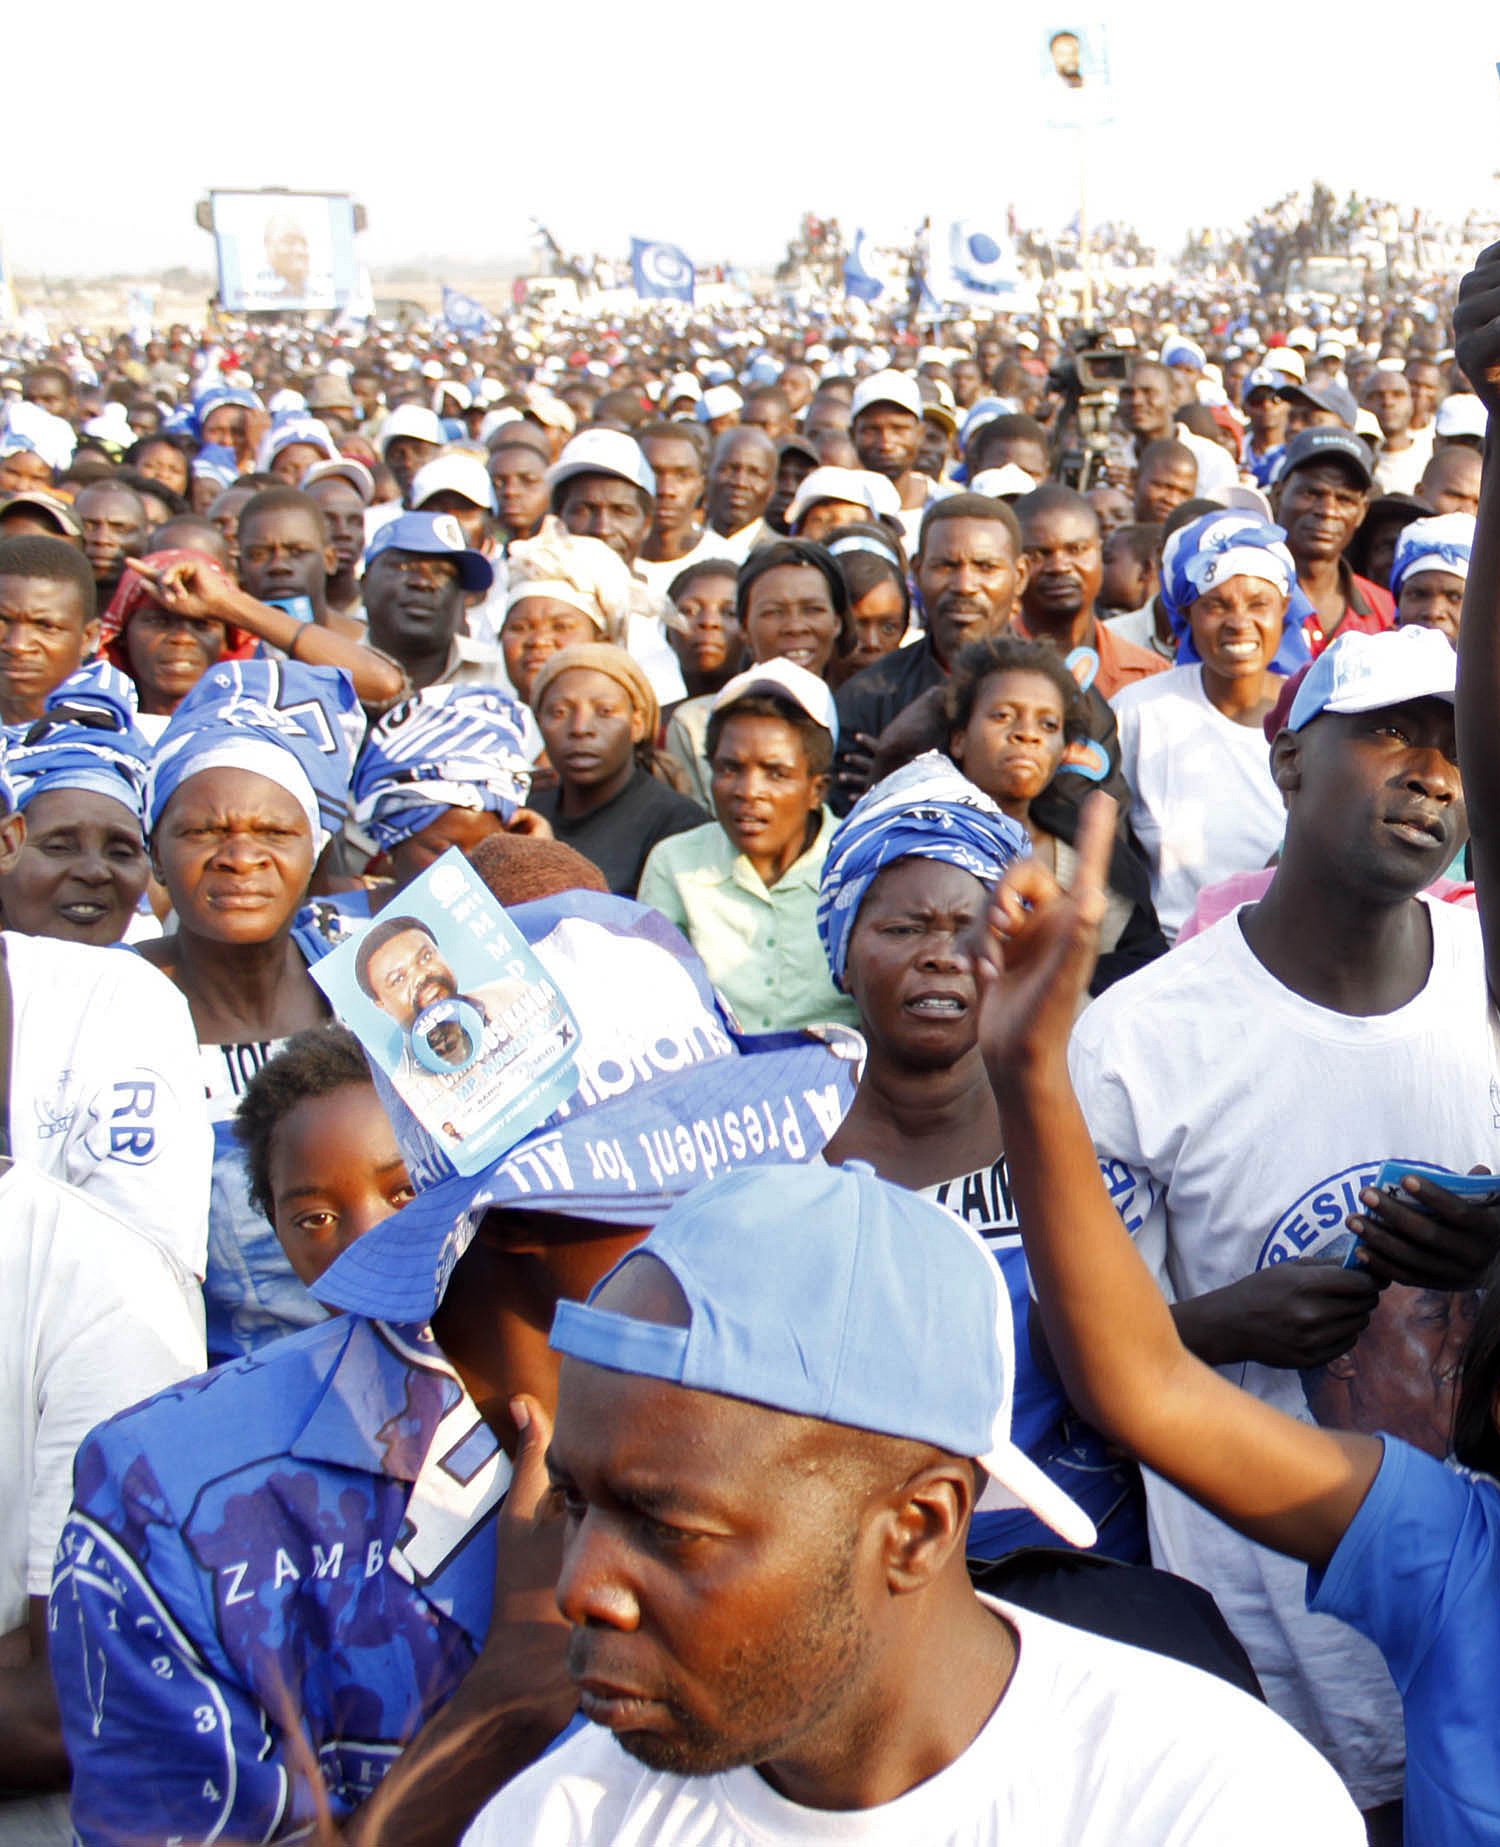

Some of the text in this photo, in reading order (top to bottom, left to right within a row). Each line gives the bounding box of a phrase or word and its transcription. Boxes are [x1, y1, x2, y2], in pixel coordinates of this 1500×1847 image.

[110, 1081, 155, 1157] RB
[639, 1096, 807, 1187] President
[803, 1083, 844, 1142] A
[496, 1138, 575, 1194] ALL
[585, 1138, 637, 1192] for
[222, 1539, 384, 1606] ZAMB
